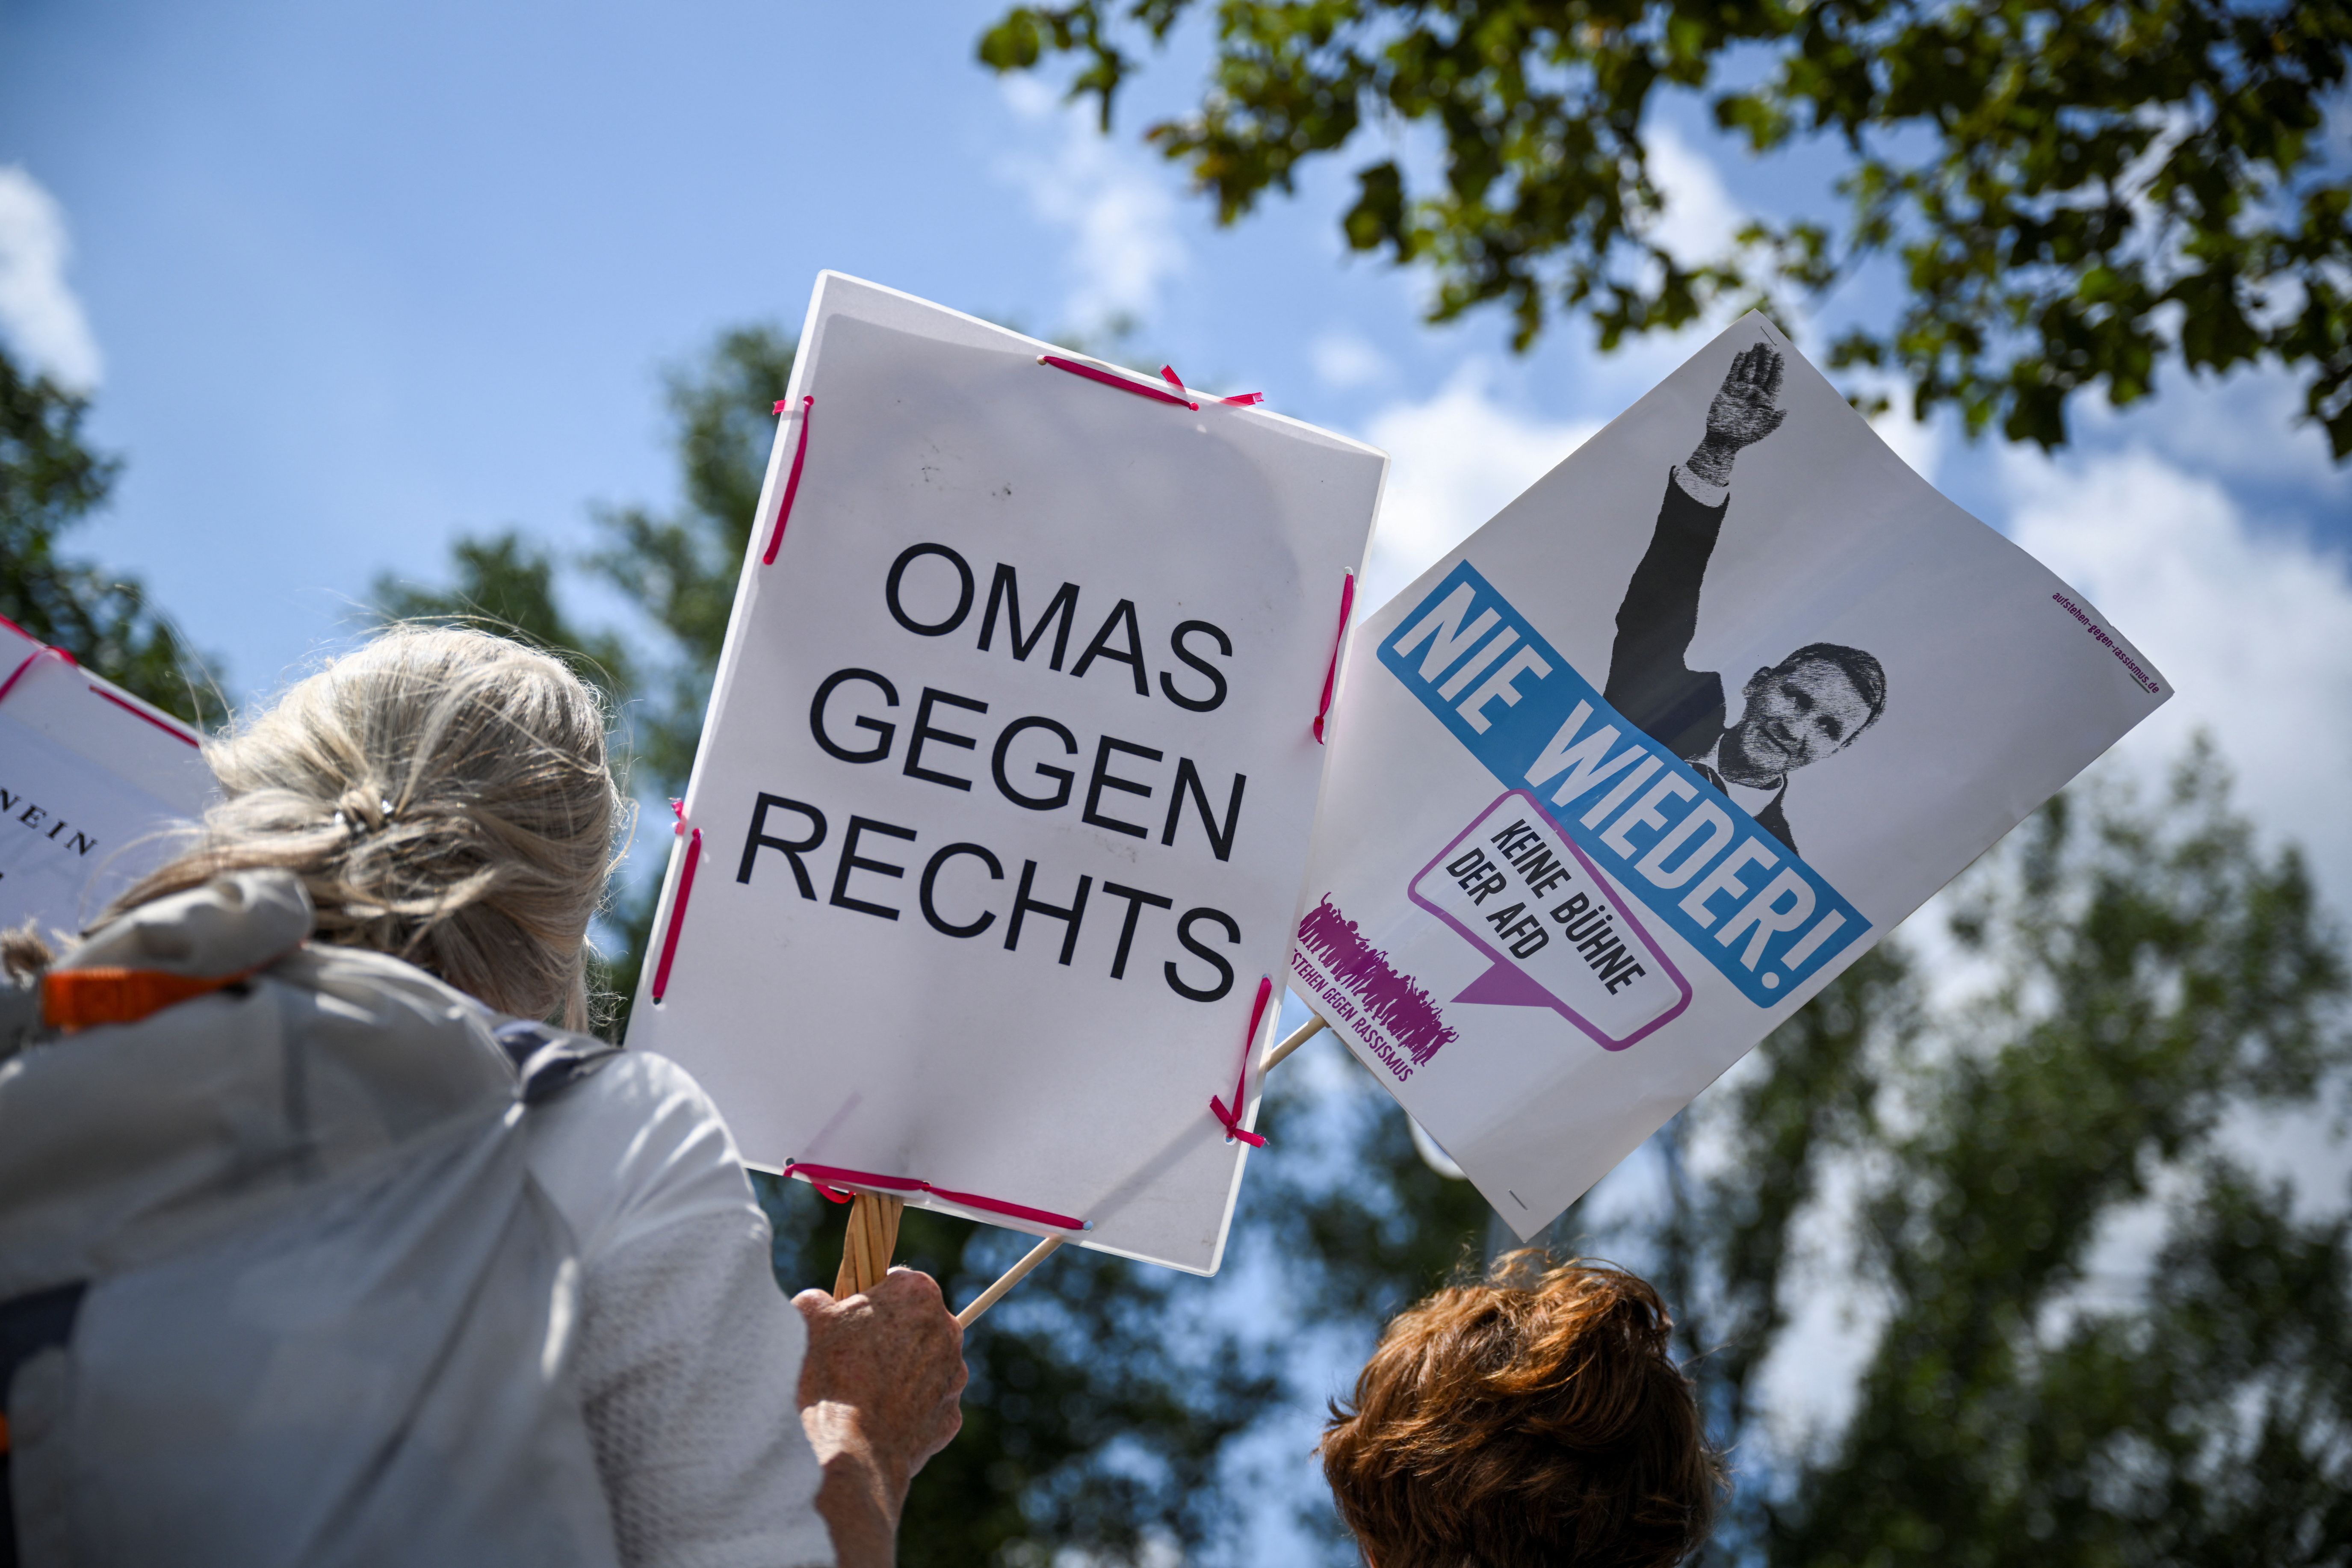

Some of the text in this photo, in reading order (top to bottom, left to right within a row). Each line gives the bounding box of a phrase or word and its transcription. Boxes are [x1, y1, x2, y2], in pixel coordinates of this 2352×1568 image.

[886, 542, 1233, 713] OMAS
[2052, 592, 2160, 694] aufstehen-gegen-rassismus.de
[810, 667, 1247, 862] GEGEN
[1392, 581, 1847, 989] NIE WIEDER!
[736, 791, 1241, 1003] RECHTS
[1445, 847, 1550, 960] DER AFD
[1490, 818, 1646, 996] KEINE BÜHNE
[1291, 948, 1413, 1082] STEHEN GEGEN RASSISMUS
